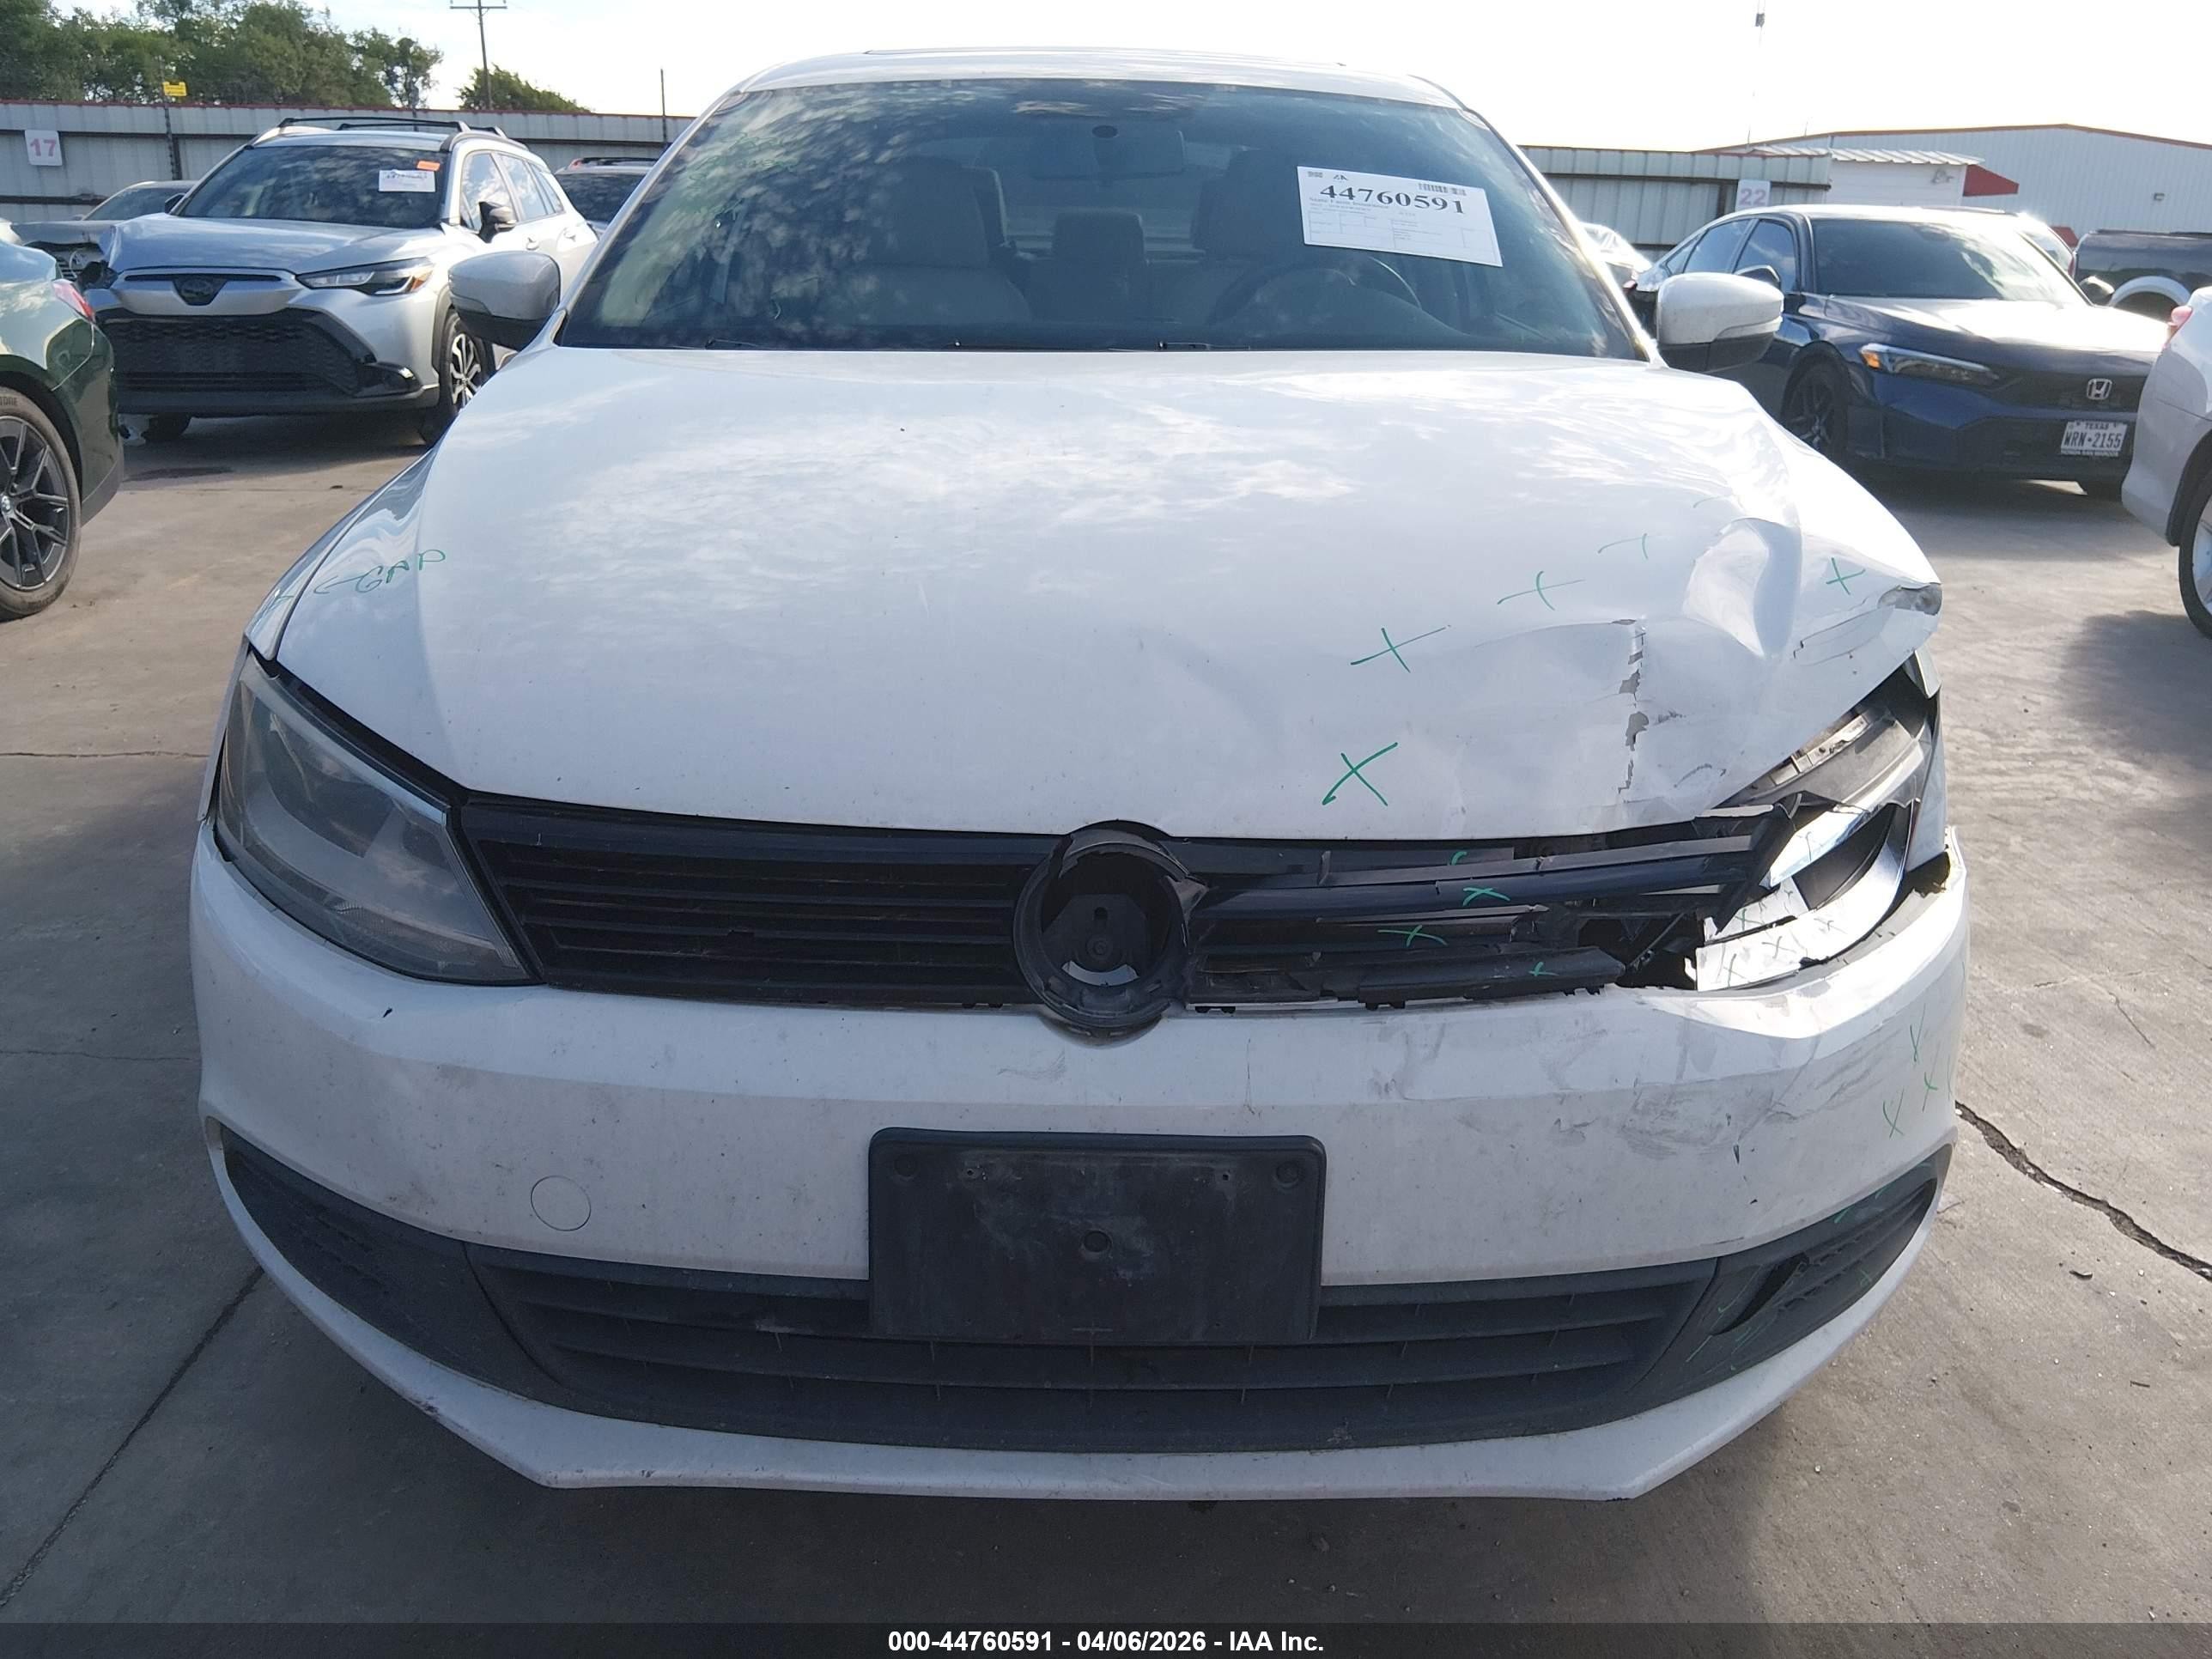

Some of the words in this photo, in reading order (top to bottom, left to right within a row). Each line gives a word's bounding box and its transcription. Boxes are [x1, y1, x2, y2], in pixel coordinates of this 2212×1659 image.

[30, 138, 56, 157] 17
[1320, 185, 1465, 215] 44760591
[1739, 188, 1766, 206] 22
